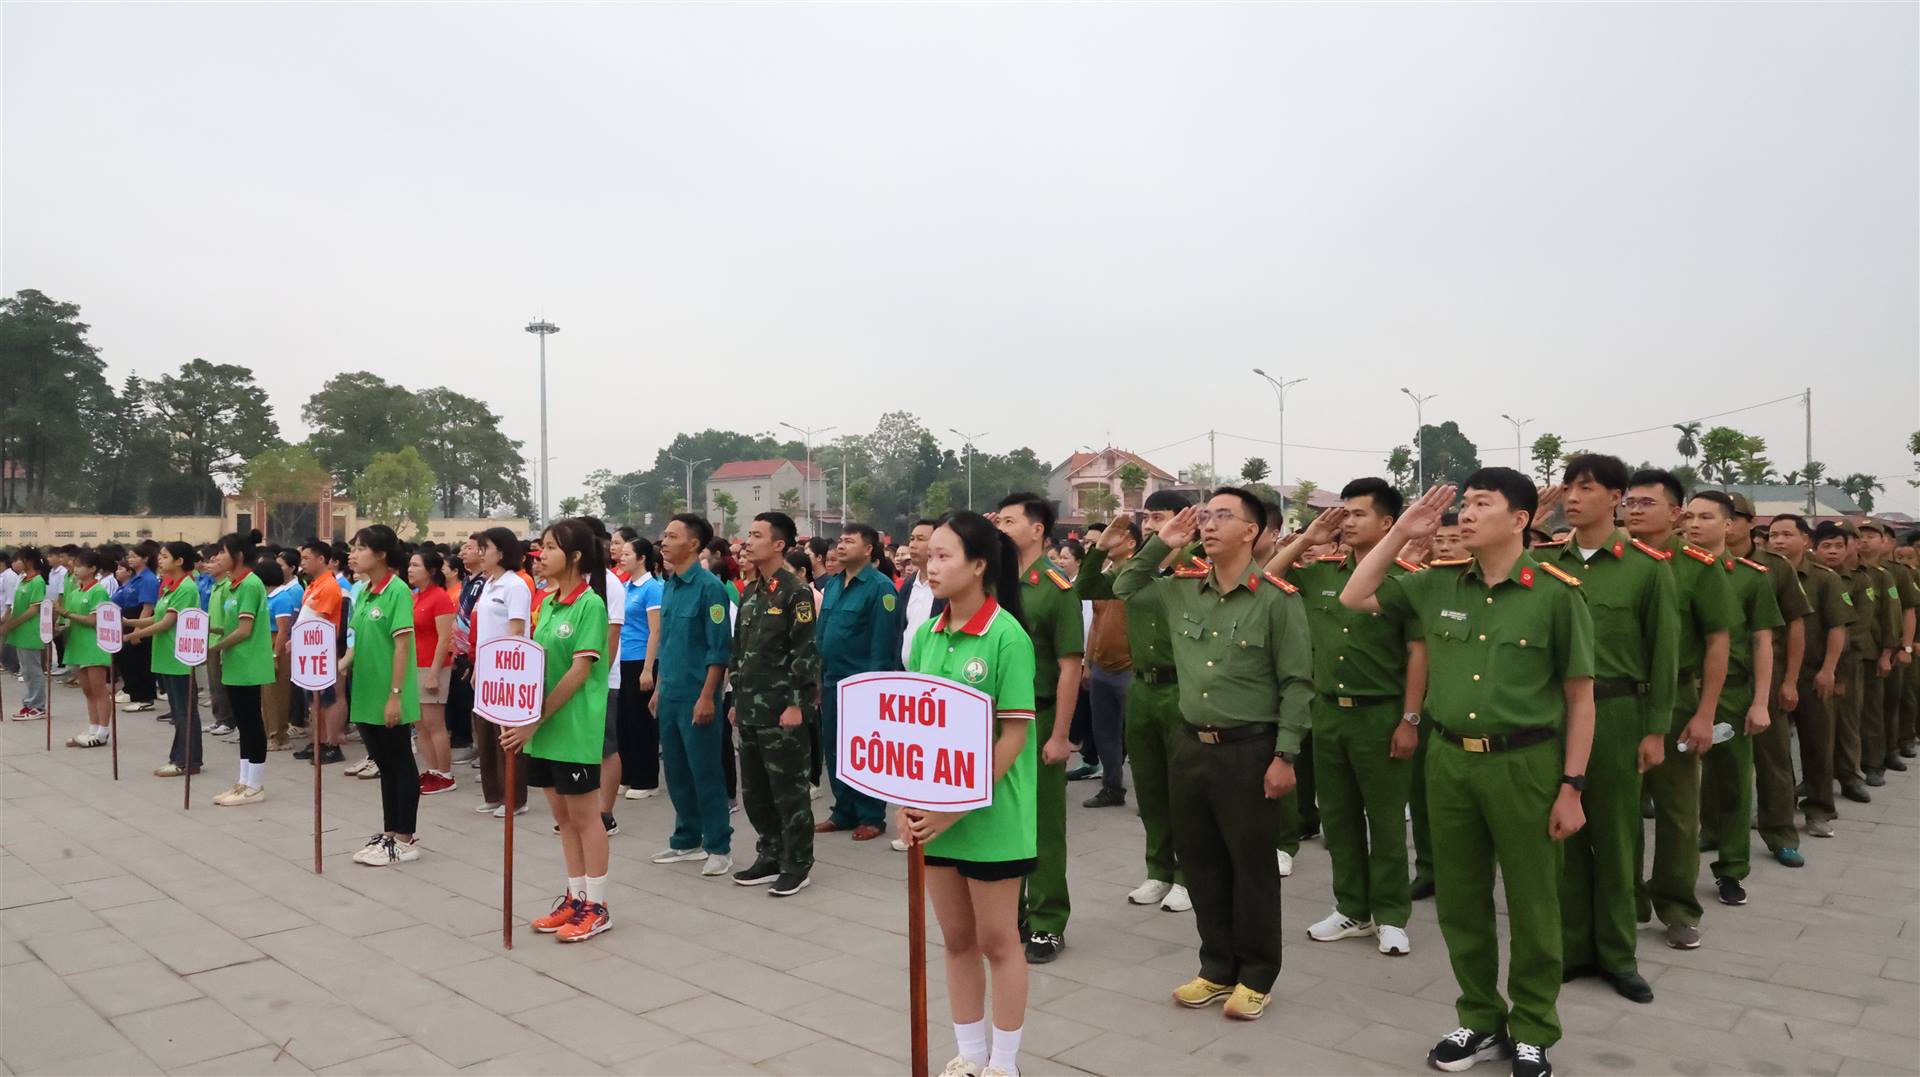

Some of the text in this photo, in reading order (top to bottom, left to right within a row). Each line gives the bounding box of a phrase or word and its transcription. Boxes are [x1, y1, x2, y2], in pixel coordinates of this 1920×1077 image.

[186, 613, 200, 630] KHỐI
[304, 624, 323, 646] KHỐI
[298, 649, 328, 675] Y TẾ
[495, 644, 525, 671] KHỐI
[482, 677, 537, 715] QUÂN SỰ
[879, 688, 946, 728] KHỐI
[850, 731, 975, 789] CÔNG AN
